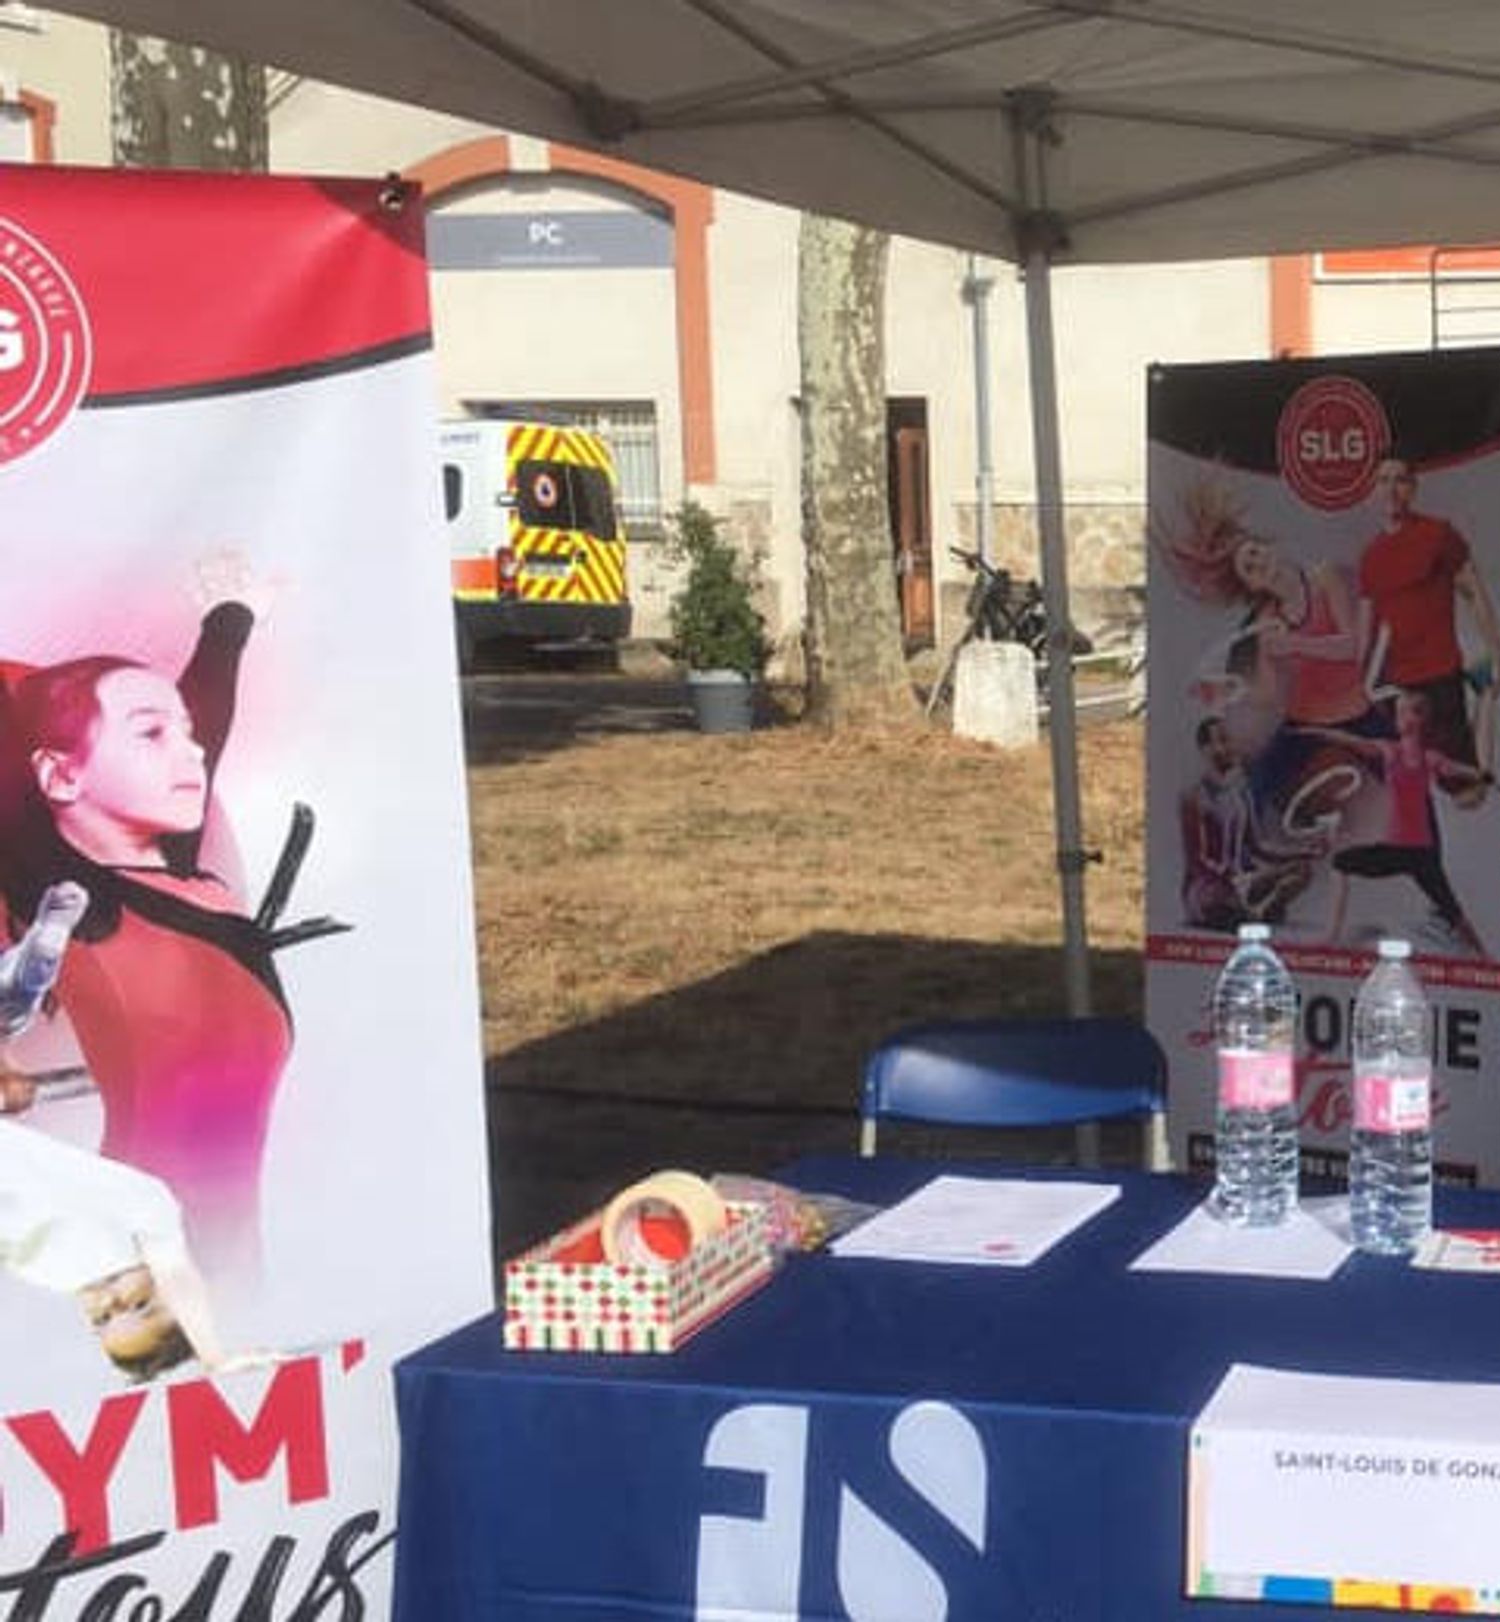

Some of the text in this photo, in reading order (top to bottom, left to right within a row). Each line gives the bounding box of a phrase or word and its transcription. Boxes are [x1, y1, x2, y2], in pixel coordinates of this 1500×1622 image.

[529, 222, 564, 246] PC
[1299, 428, 1366, 461] SLG
[0, 1338, 366, 1560] YM'
[1274, 1450, 1406, 1476] SAINT-LOUIS
[1412, 1457, 1440, 1477] DE
